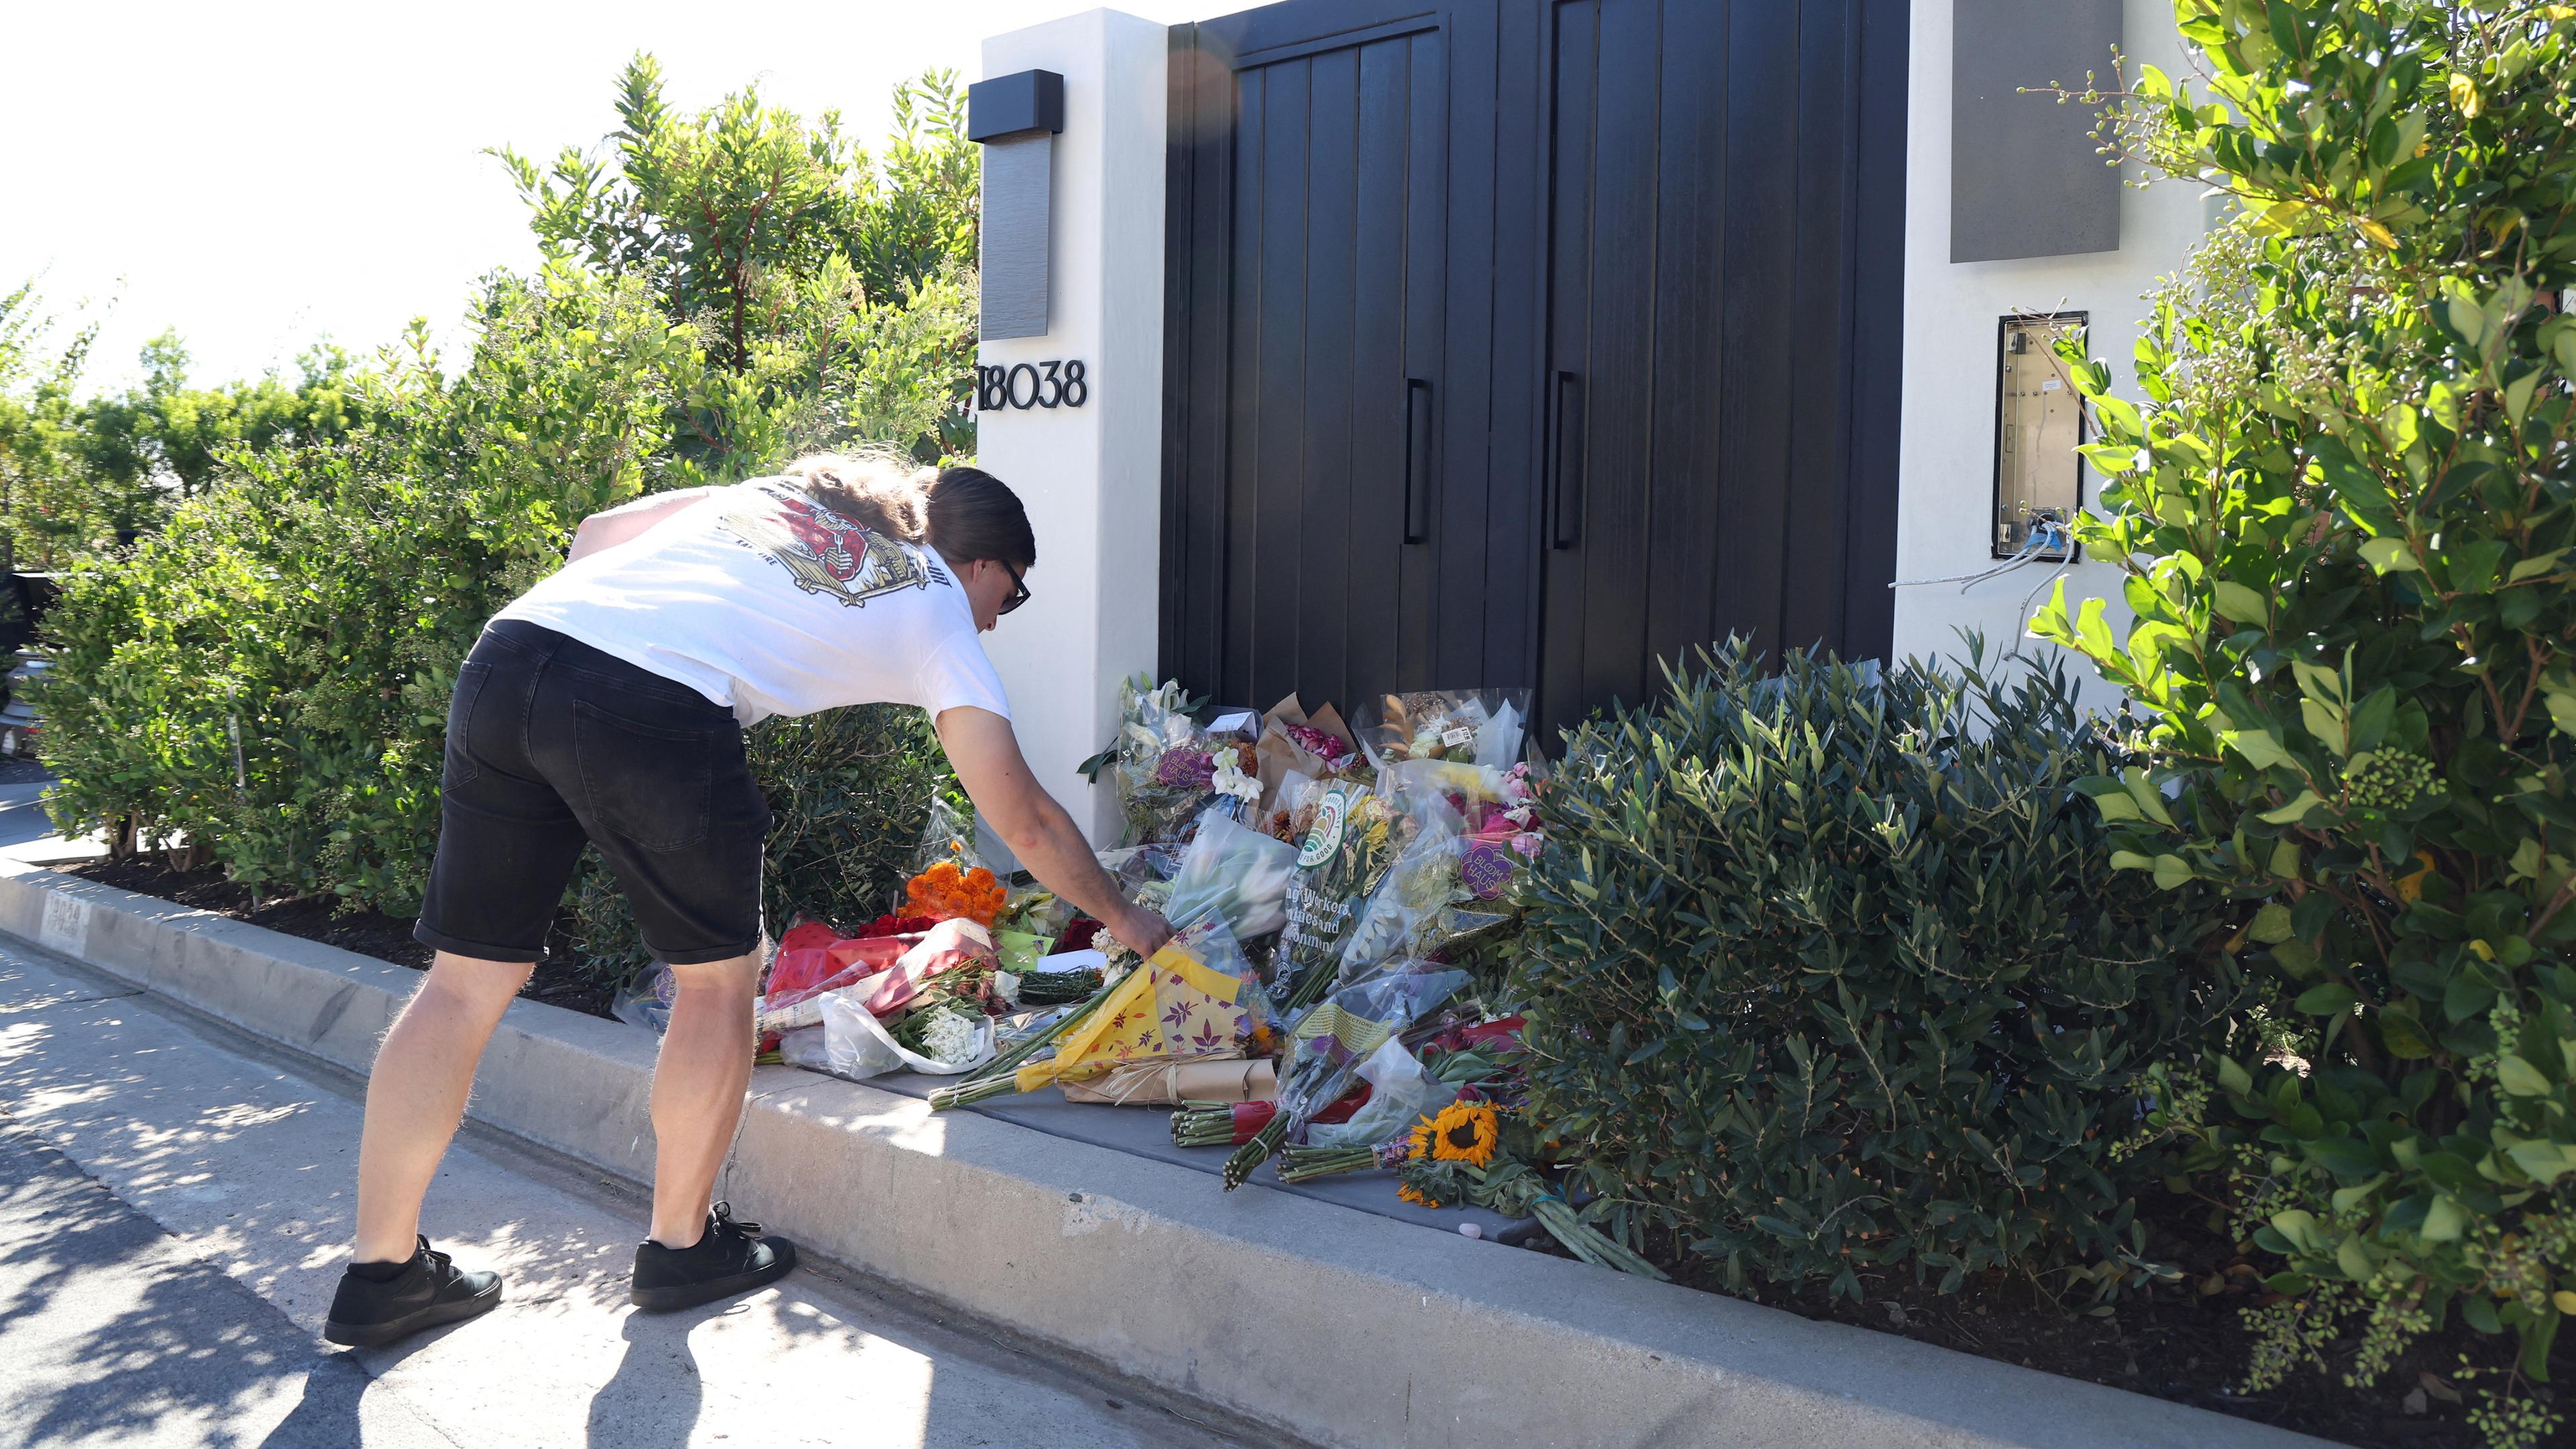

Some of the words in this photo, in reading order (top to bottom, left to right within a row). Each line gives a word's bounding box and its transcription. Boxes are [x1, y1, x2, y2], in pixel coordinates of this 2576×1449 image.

[975, 360, 1087, 411] 18038
[1166, 763, 1190, 782] HAUS
[1170, 756, 1195, 774] BLOOM
[1316, 843, 1332, 860] GOOD
[1474, 855, 1503, 881] BLOOM
[1467, 864, 1496, 891] HAUS
[1319, 920, 1339, 934] and
[1339, 1010, 1373, 1028] DIRECTIONS
